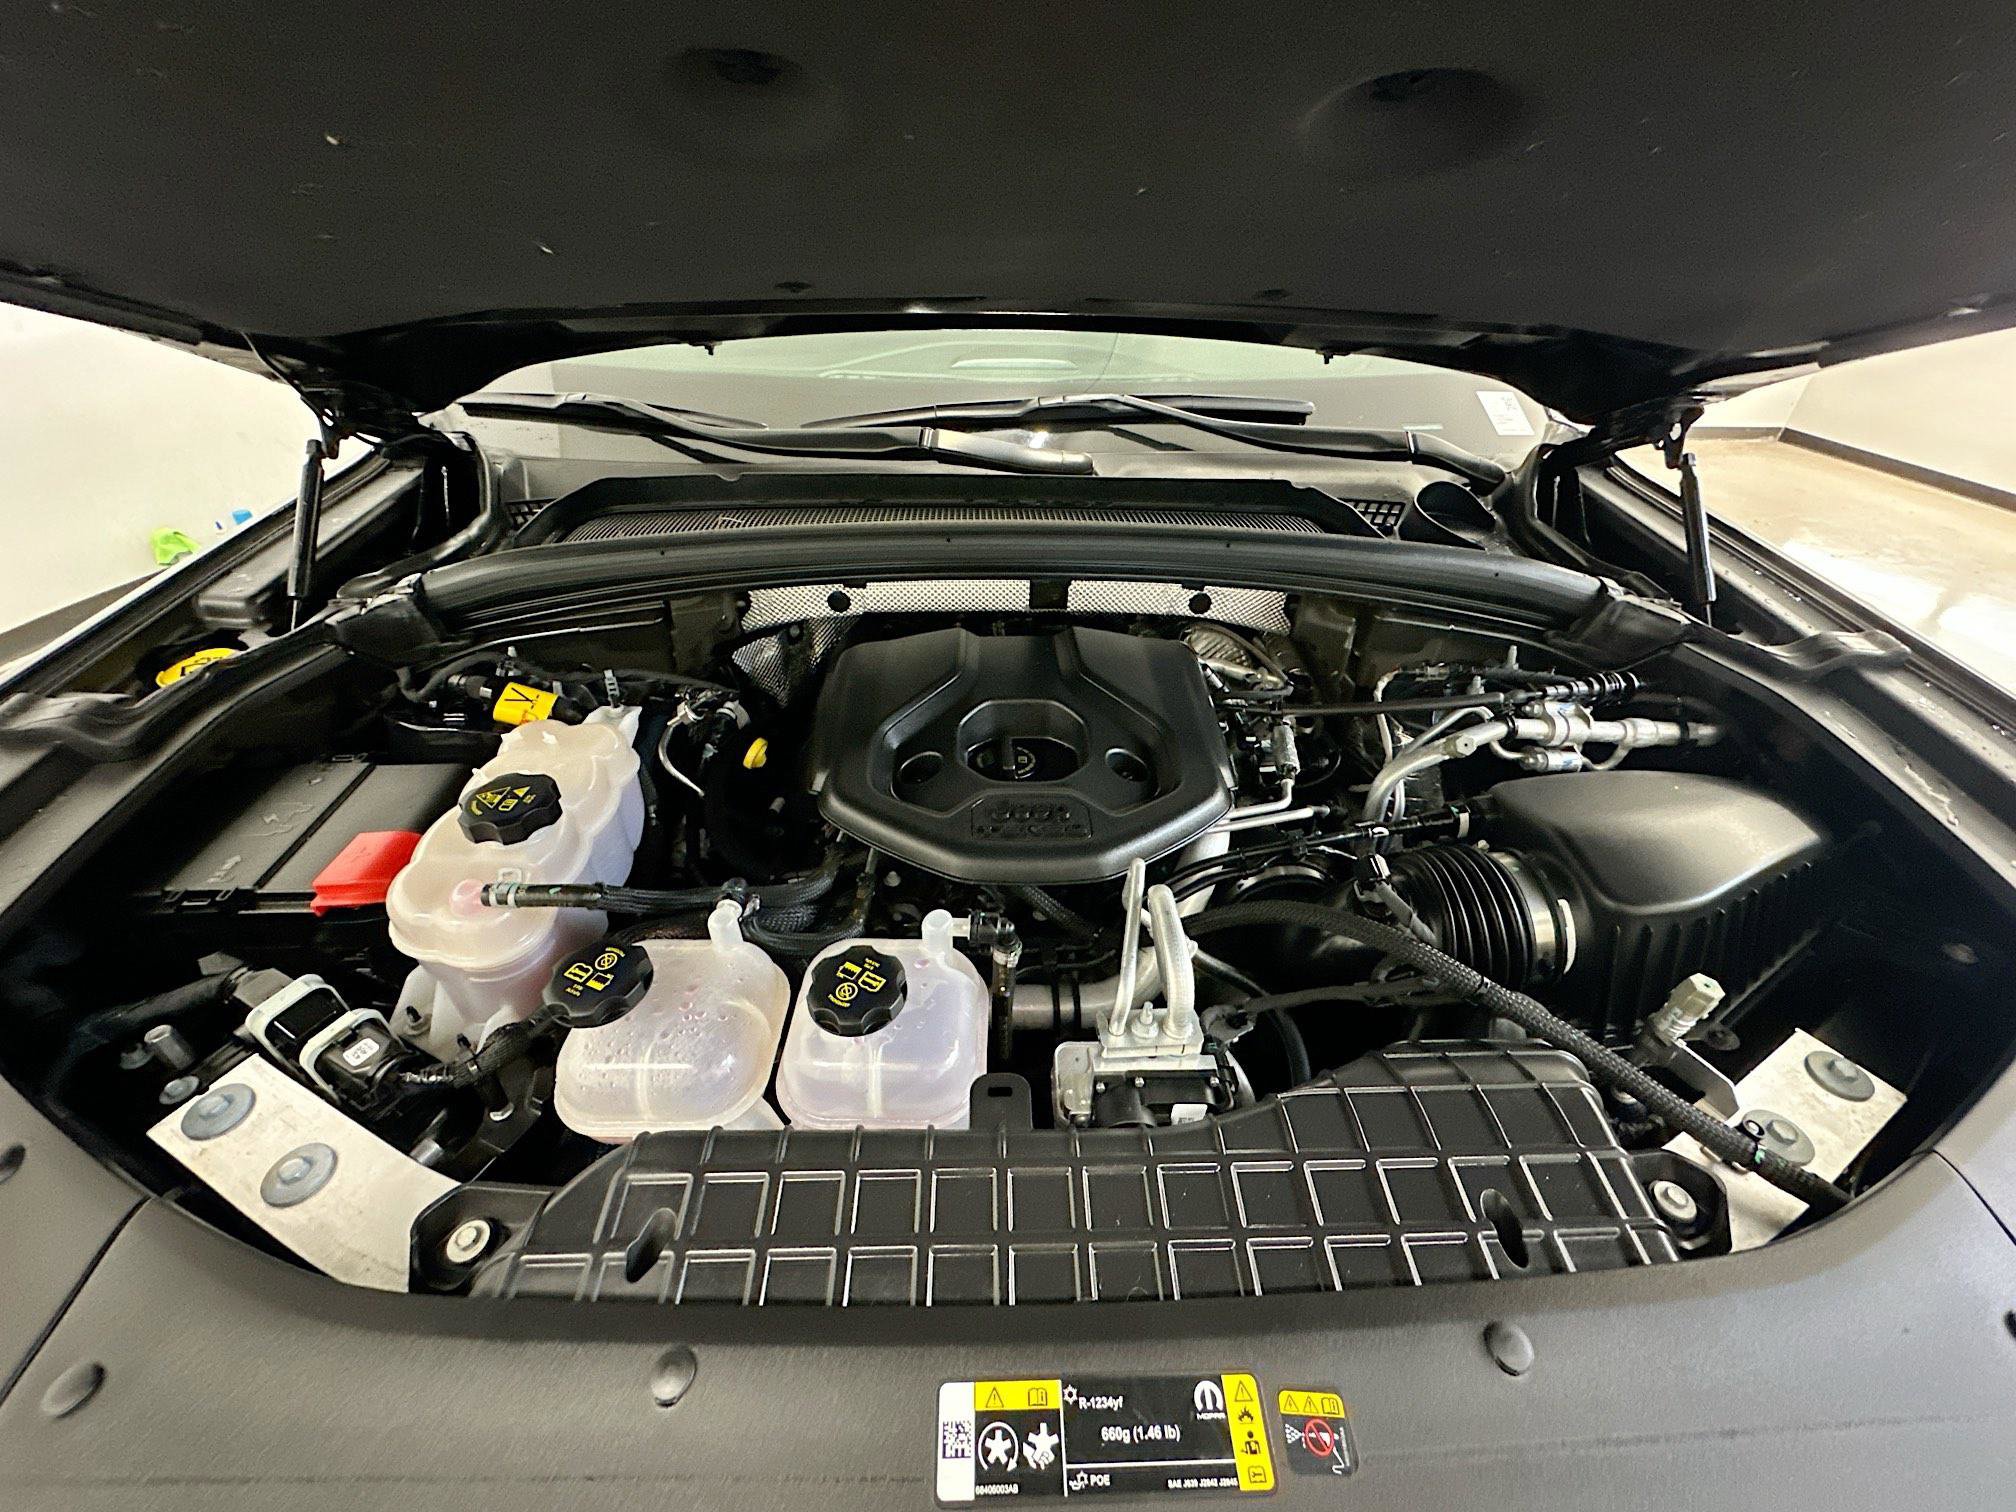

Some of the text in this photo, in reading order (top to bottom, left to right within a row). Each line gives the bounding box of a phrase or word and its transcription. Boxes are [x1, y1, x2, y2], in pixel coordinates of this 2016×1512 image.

[1079, 1395, 1124, 1412] R-1234yf
[1101, 1424, 1181, 1444] 660g (1.46 lb)
[1090, 1474, 1111, 1487] POE
